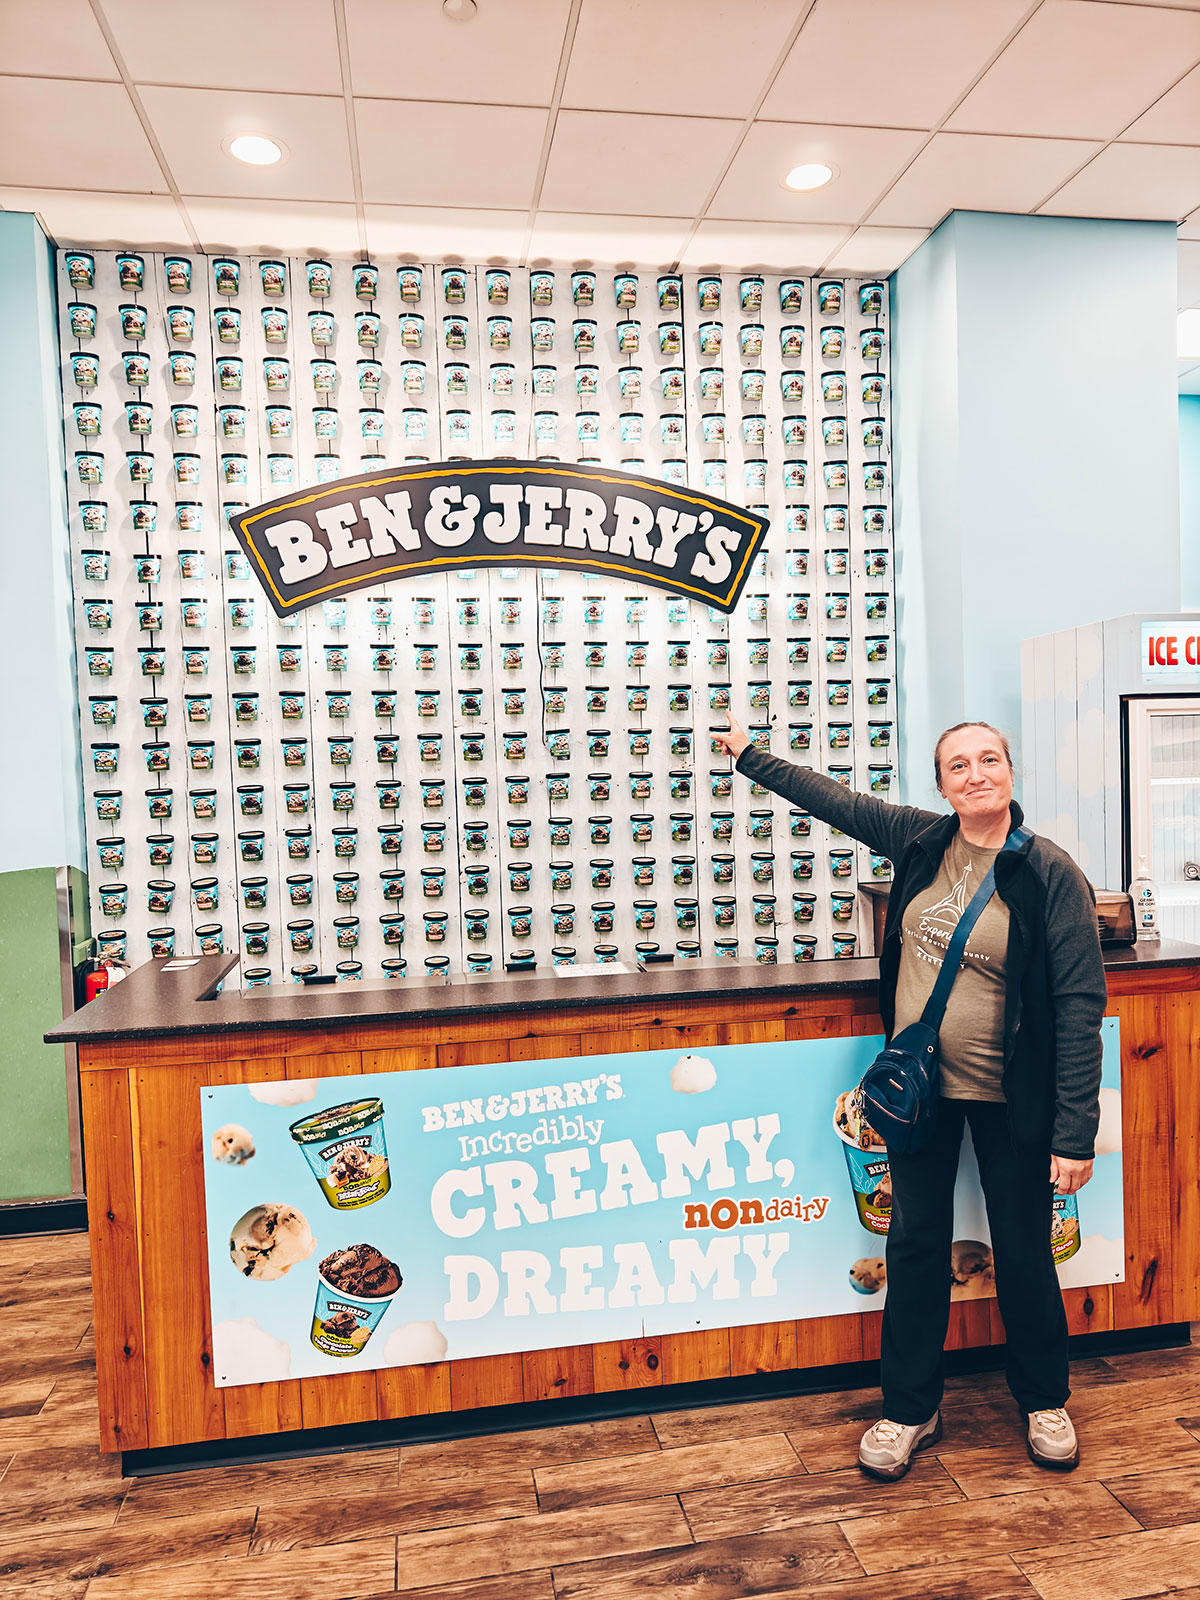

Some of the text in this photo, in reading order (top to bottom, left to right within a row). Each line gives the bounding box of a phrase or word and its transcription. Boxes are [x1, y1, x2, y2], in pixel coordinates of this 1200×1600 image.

[1148, 636, 1178, 666] ICE
[963, 951, 990, 961] ounty
[458, 1115, 605, 1162] Incredibly
[430, 1113, 795, 1238] CREAMY,
[443, 1232, 790, 1321] DREAMY
